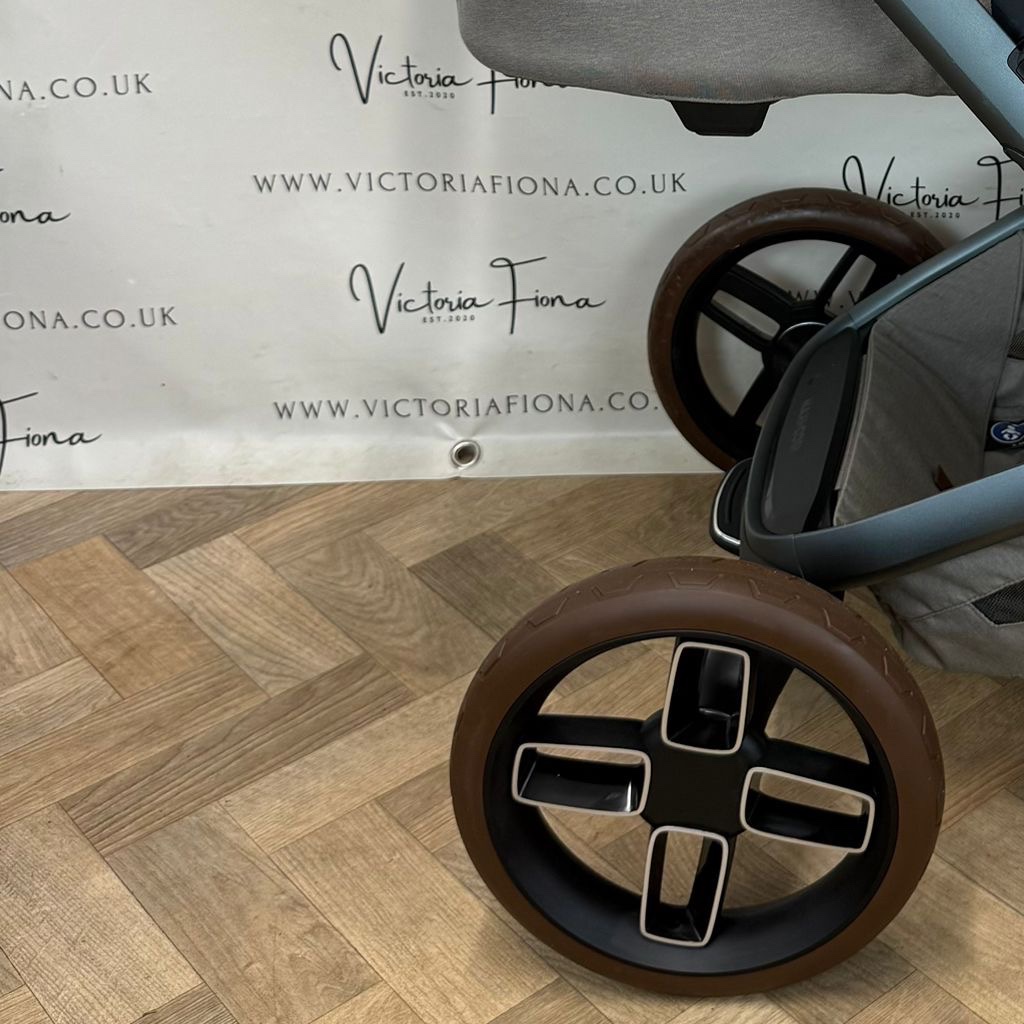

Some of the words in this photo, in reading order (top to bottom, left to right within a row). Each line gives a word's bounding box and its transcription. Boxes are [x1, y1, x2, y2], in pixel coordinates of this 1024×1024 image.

[329, 33, 474, 105] Victoria
[404, 90, 456, 99] EST.2020
[252, 172, 687, 197] WWW.VICTORIAFIONA.CO.UK
[348, 262, 494, 335] Victoria
[489, 256, 606, 335] Fiona
[422, 314, 476, 323] EST.2020
